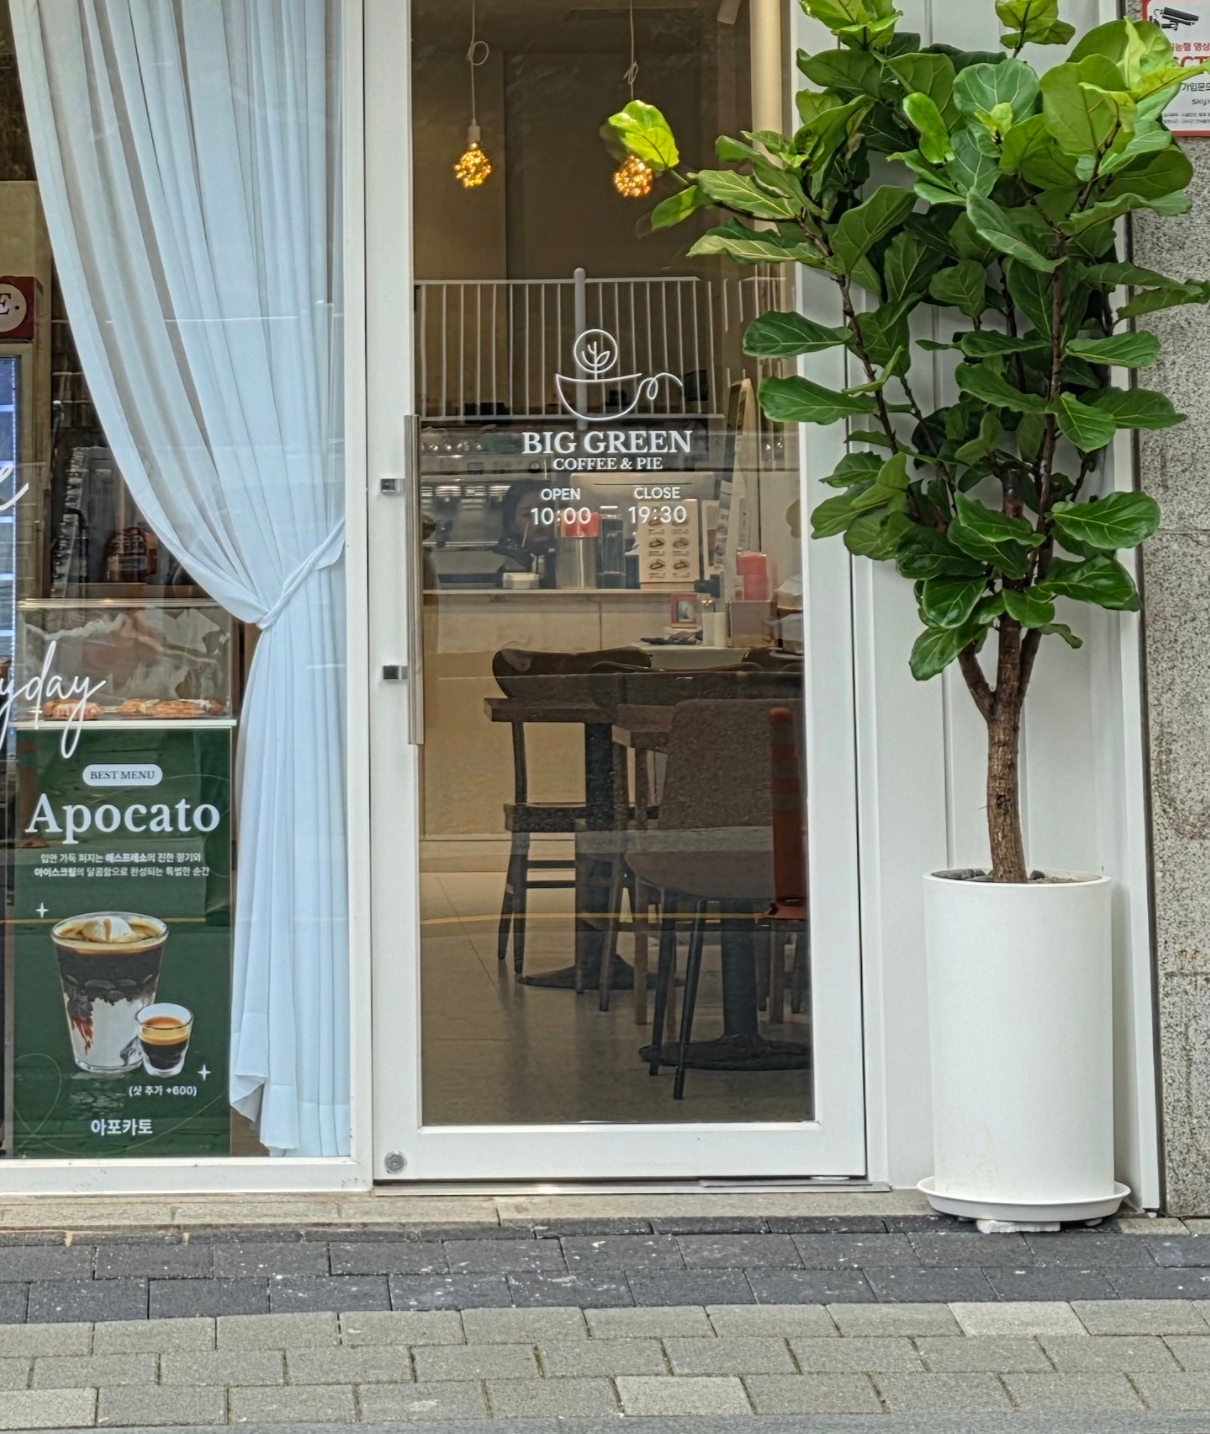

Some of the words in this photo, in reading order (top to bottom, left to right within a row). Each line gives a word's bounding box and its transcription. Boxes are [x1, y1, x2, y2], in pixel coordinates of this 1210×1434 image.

[522, 430, 578, 455] BIG
[584, 430, 692, 454] GREEN
[553, 458, 618, 471] COFFEE
[620, 458, 632, 470] &
[636, 457, 663, 470] PIE
[540, 488, 581, 501] OPEN
[633, 486, 680, 500] CLOSE
[530, 506, 591, 525] 10:00
[628, 505, 687, 524] 19:30
[90, 770, 119, 780] BEST
[121, 770, 156, 780] MENU
[25, 792, 220, 844] Apocato
[105, 853, 155, 862] 에스프레소의
[145, 1086, 163, 1096] 추가
[166, 1085, 197, 1096] +600)
[91, 1119, 153, 1136] 아포카토
